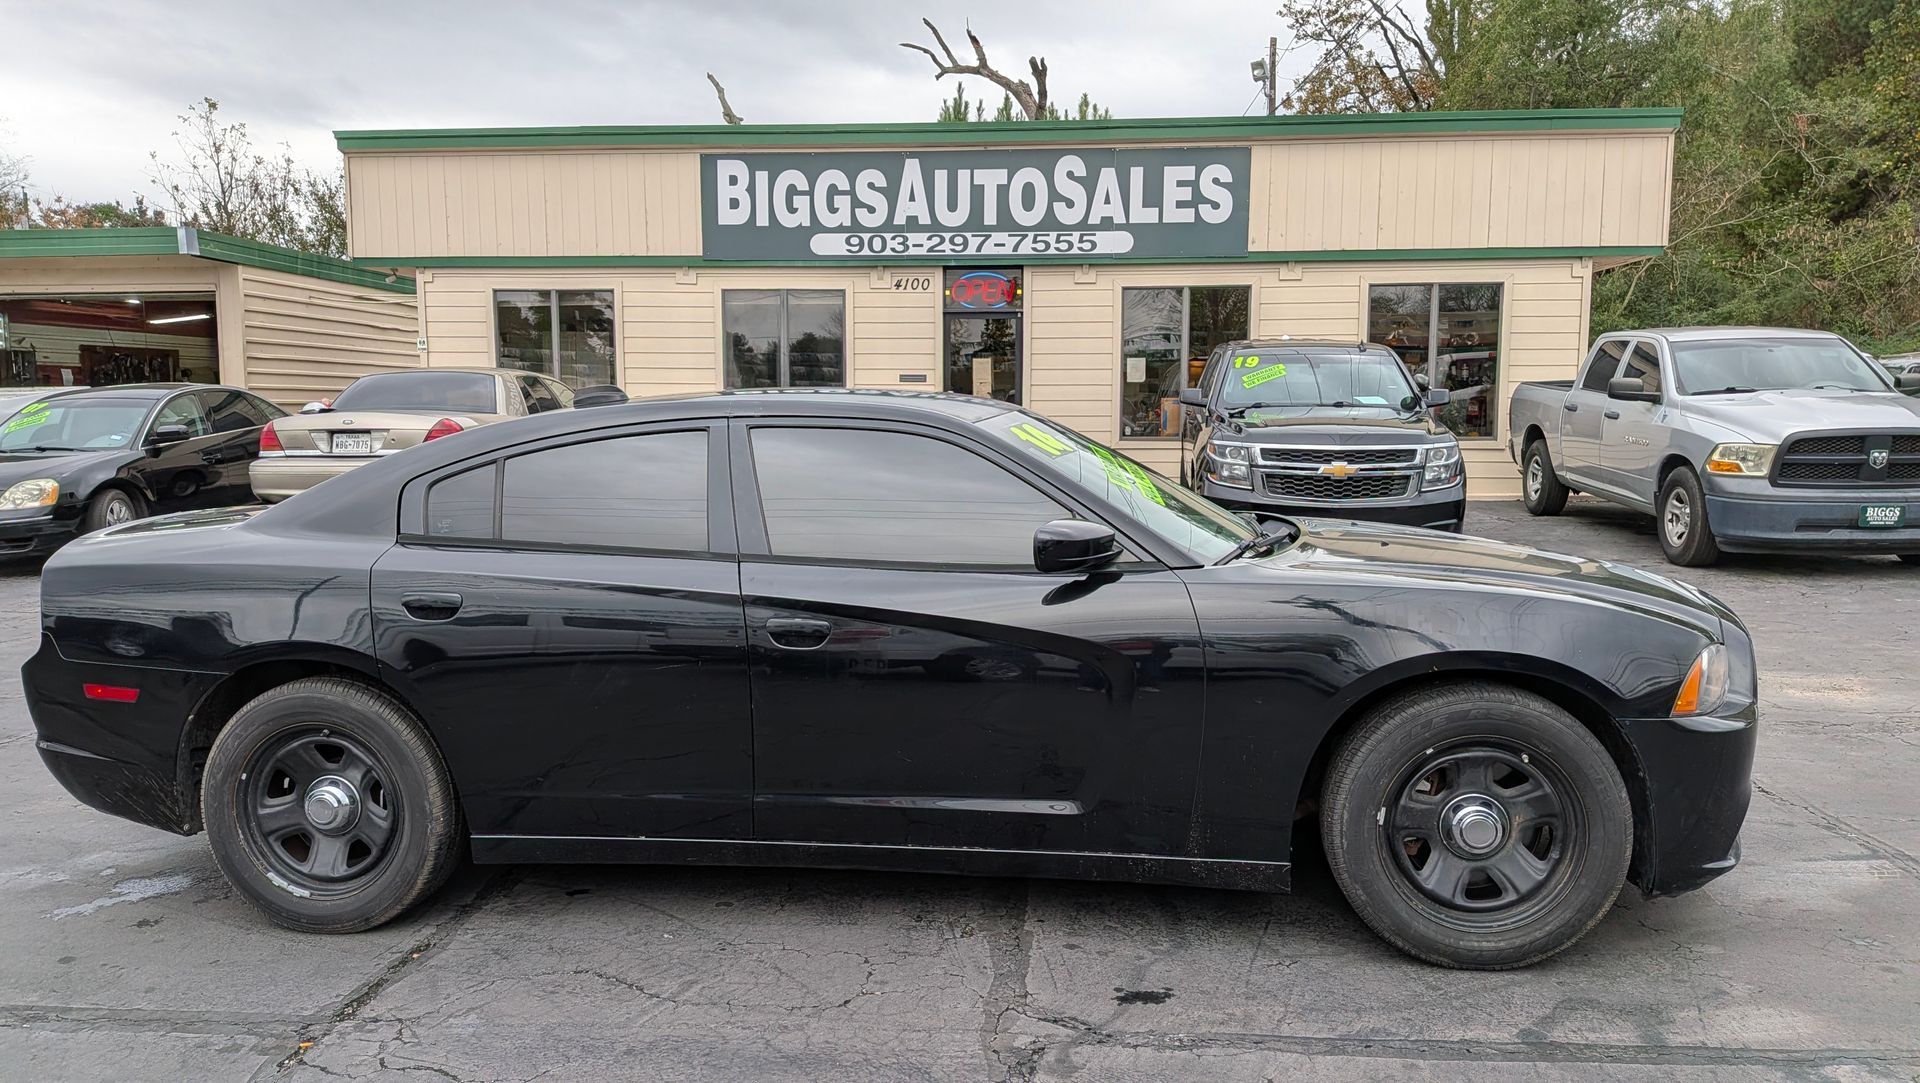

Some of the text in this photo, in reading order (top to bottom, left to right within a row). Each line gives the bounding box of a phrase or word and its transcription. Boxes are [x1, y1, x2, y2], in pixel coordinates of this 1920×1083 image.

[716, 155, 1234, 228] BIGGS AUTO SALES
[844, 232, 1098, 255] 903-297-7555
[894, 278, 930, 290] 4100
[951, 278, 1016, 303] OPEN
[1234, 356, 1260, 369] 19
[1246, 365, 1281, 380] WARRANTY
[1256, 370, 1283, 383] FINANCE
[1865, 507, 1901, 517] BIGGS
